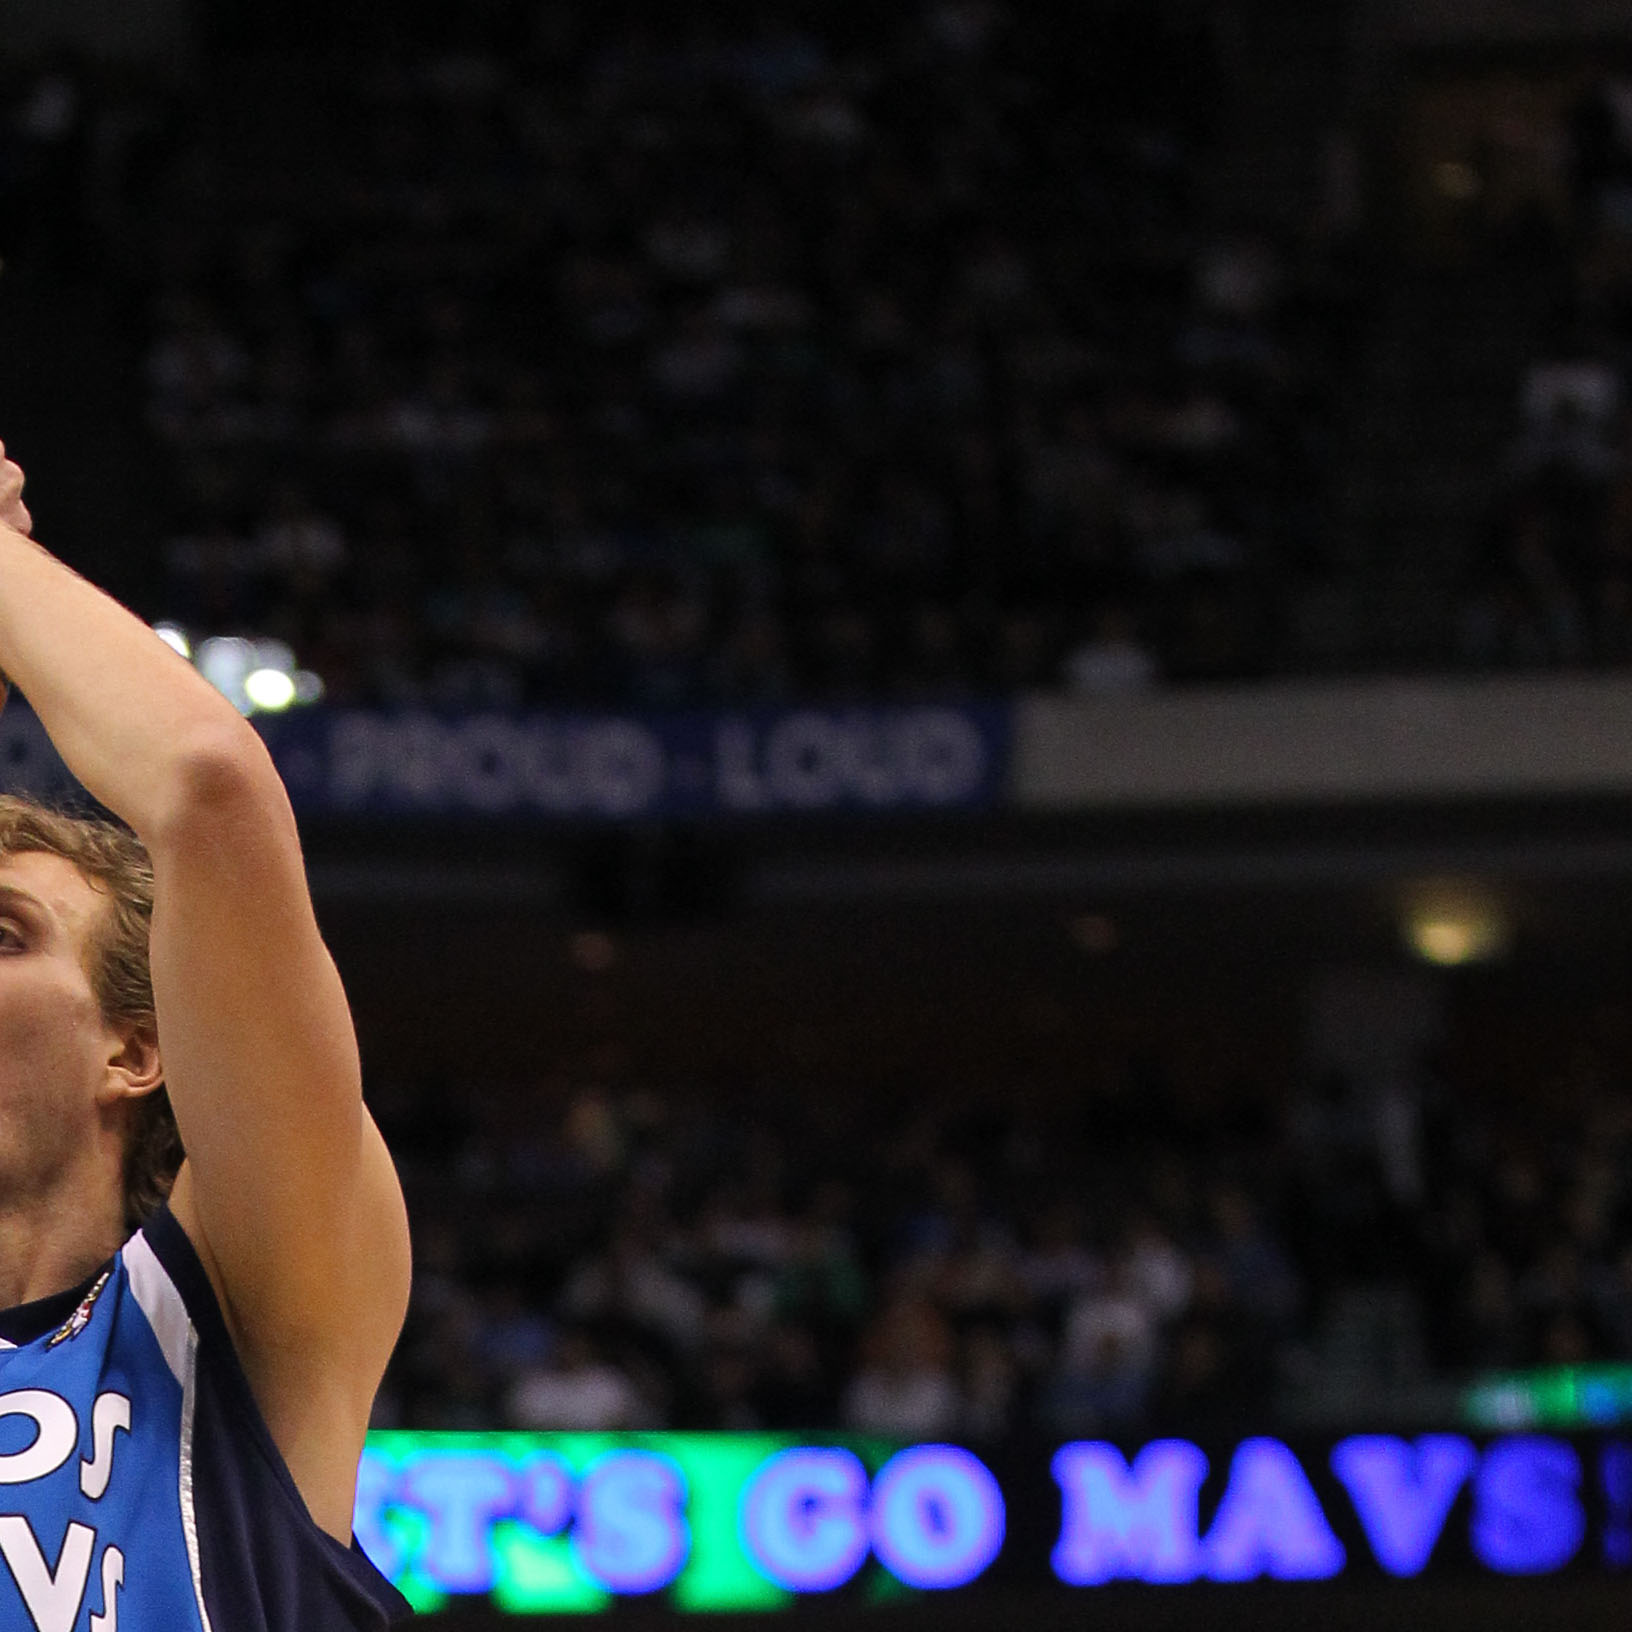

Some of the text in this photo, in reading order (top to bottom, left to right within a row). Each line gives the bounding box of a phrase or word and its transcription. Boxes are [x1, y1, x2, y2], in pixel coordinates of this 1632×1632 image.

[324, 702, 988, 818] PROUD LOUD
[741, 1443, 1005, 1593] GO
